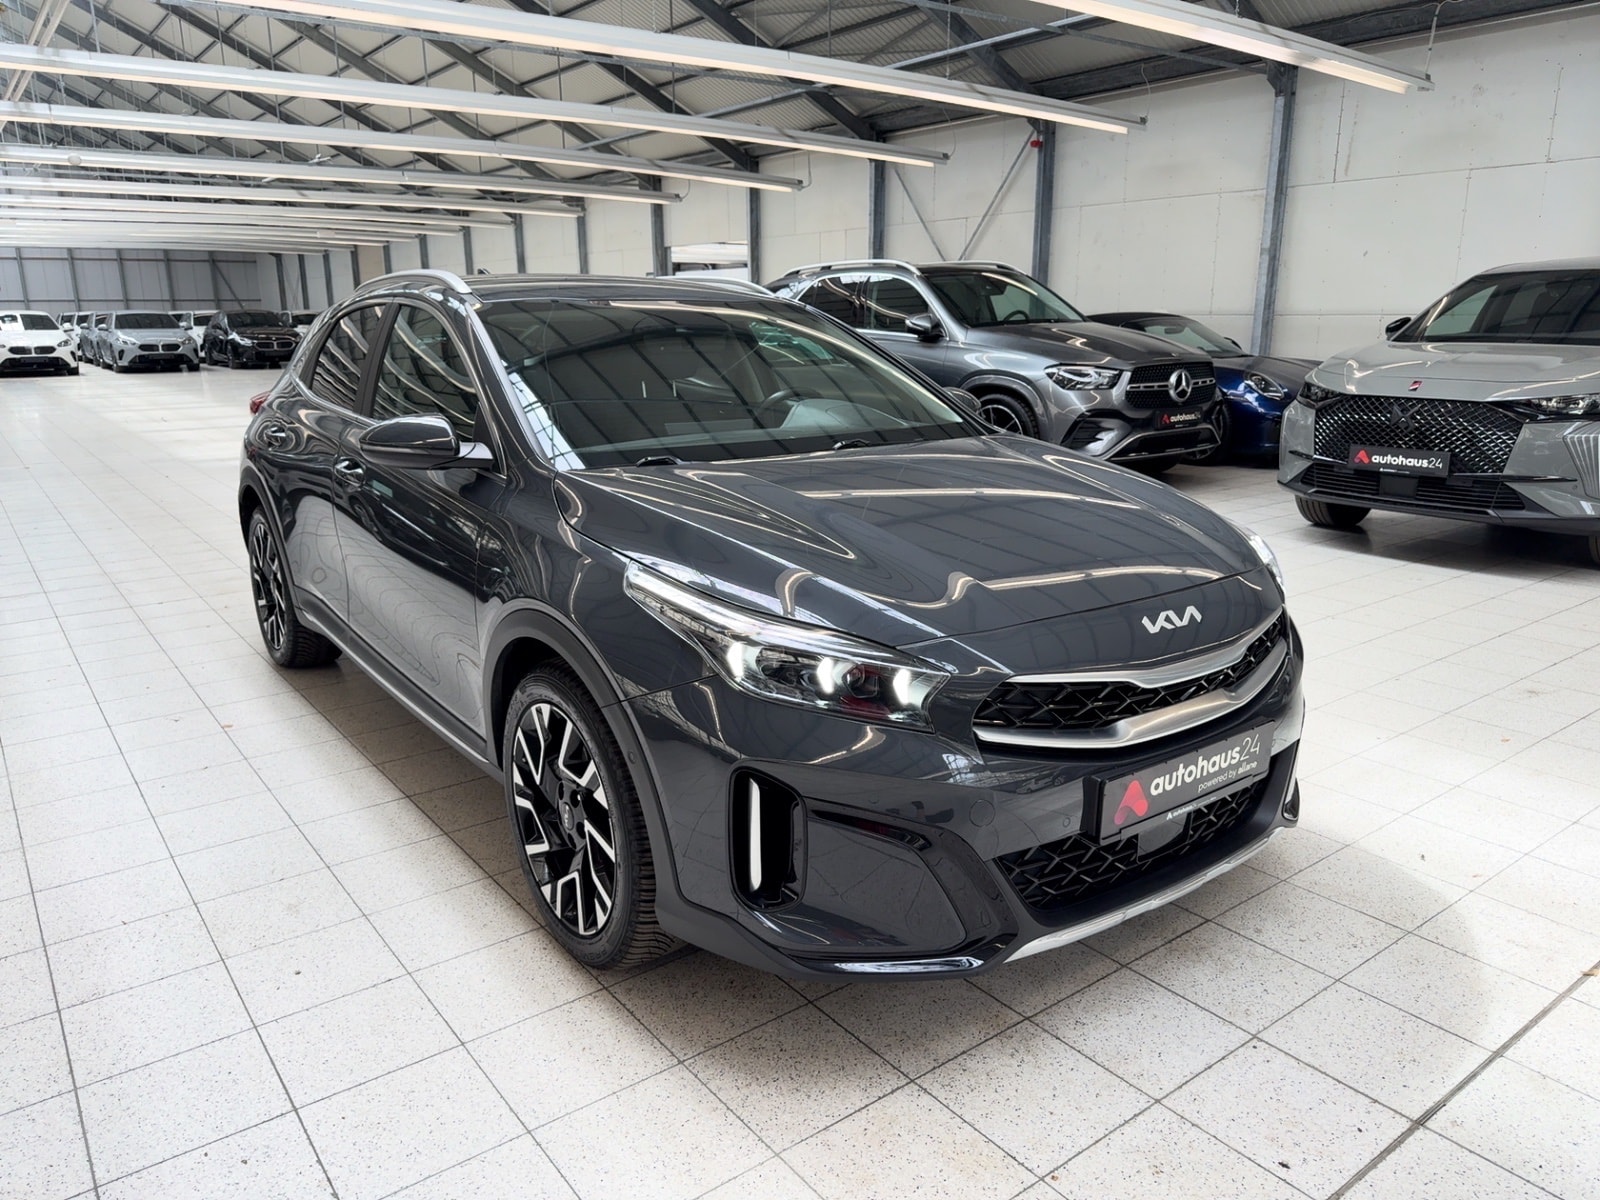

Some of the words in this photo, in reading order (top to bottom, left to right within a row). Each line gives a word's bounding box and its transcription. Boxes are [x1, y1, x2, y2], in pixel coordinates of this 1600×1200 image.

[1371, 454, 1443, 469] autohaus24
[1141, 605, 1202, 634] KIA
[1150, 733, 1260, 796] autohaus24
[1198, 770, 1228, 793] powered
[1228, 769, 1237, 779] by
